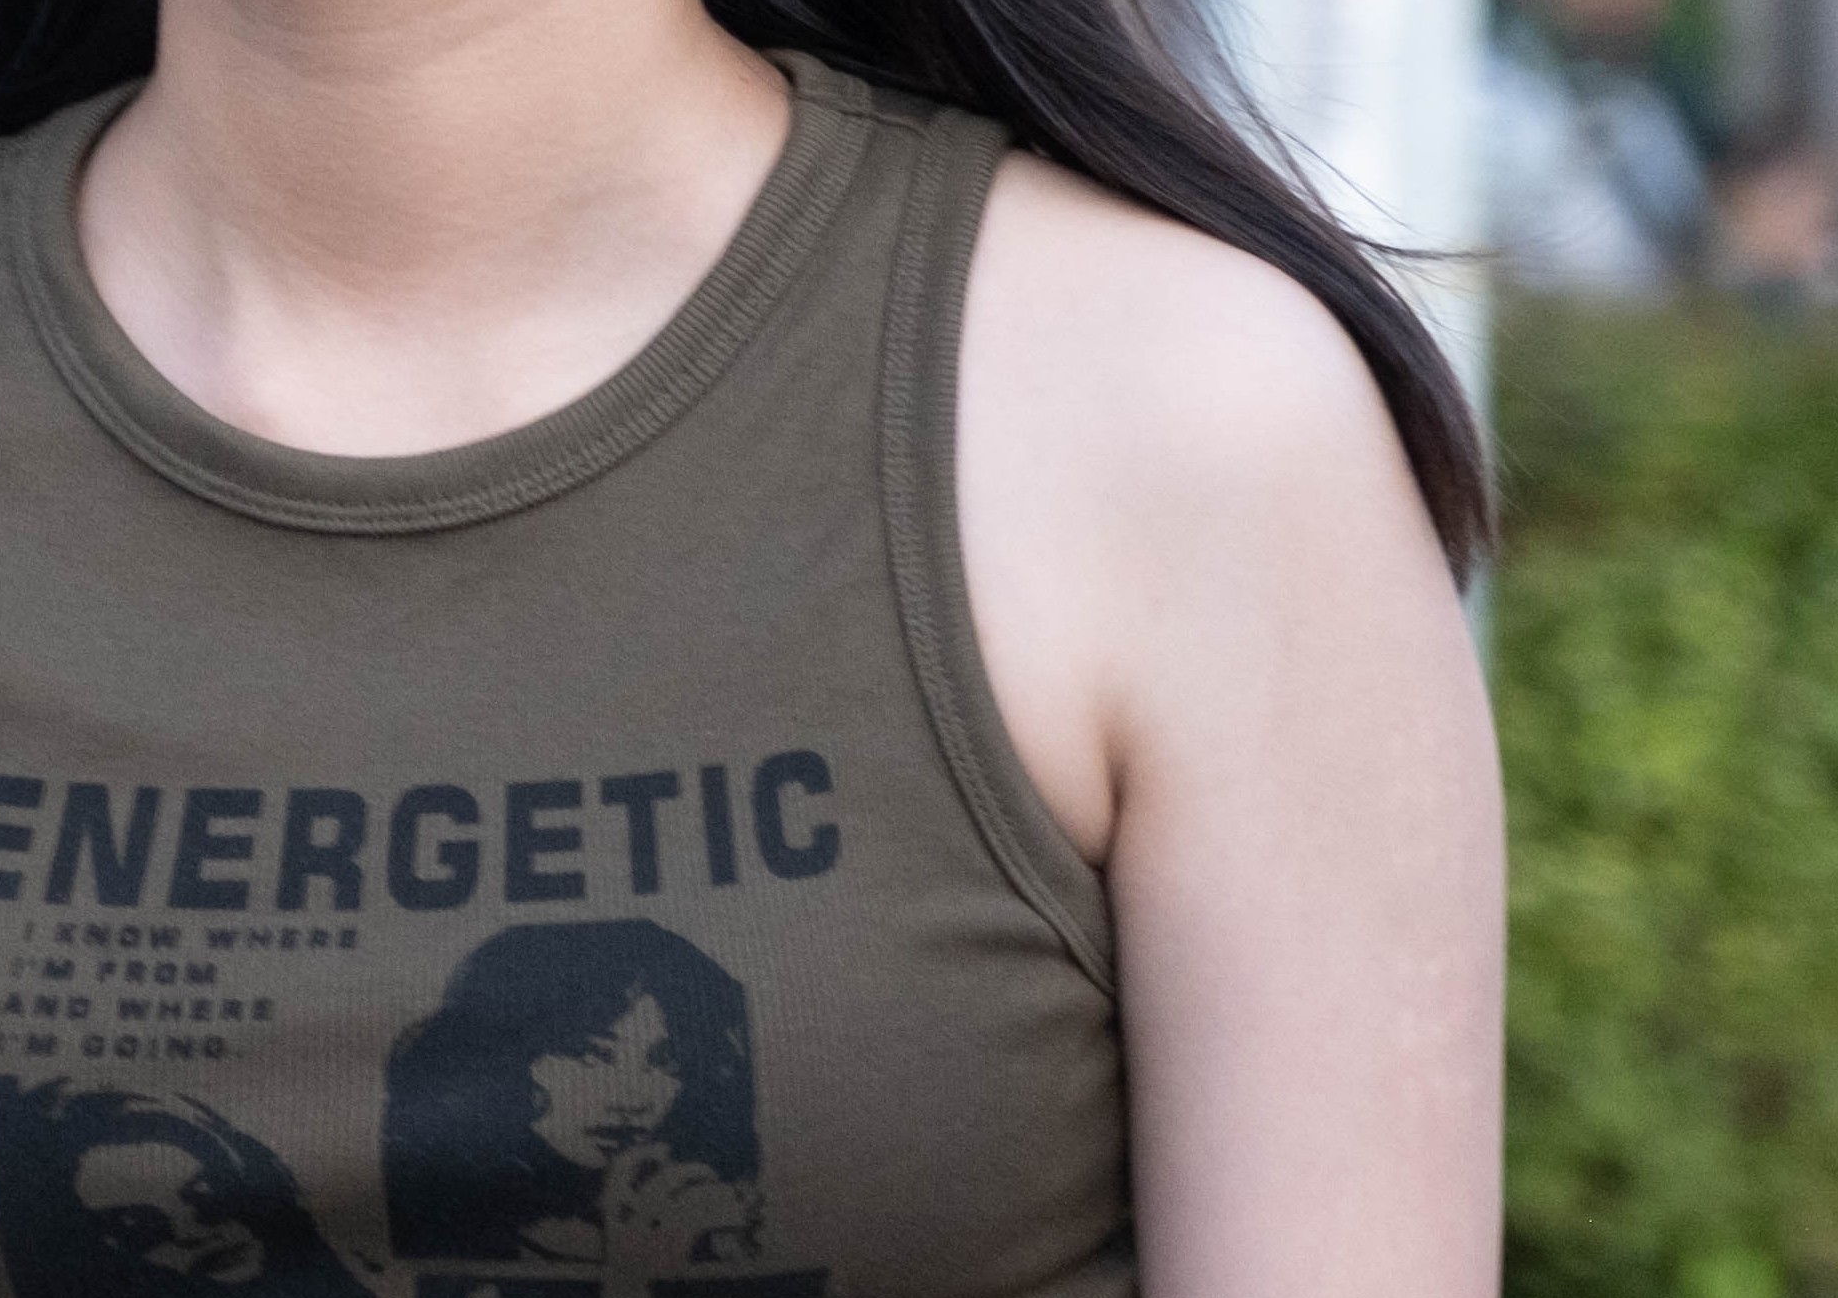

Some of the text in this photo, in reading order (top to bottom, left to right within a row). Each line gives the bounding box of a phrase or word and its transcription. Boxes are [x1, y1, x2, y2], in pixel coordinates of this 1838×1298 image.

[55, 922, 182, 950] KNOW
[205, 926, 359, 951] WHERE
[10, 958, 218, 986] I'M FROM
[0, 992, 275, 1022] AND WHERE
